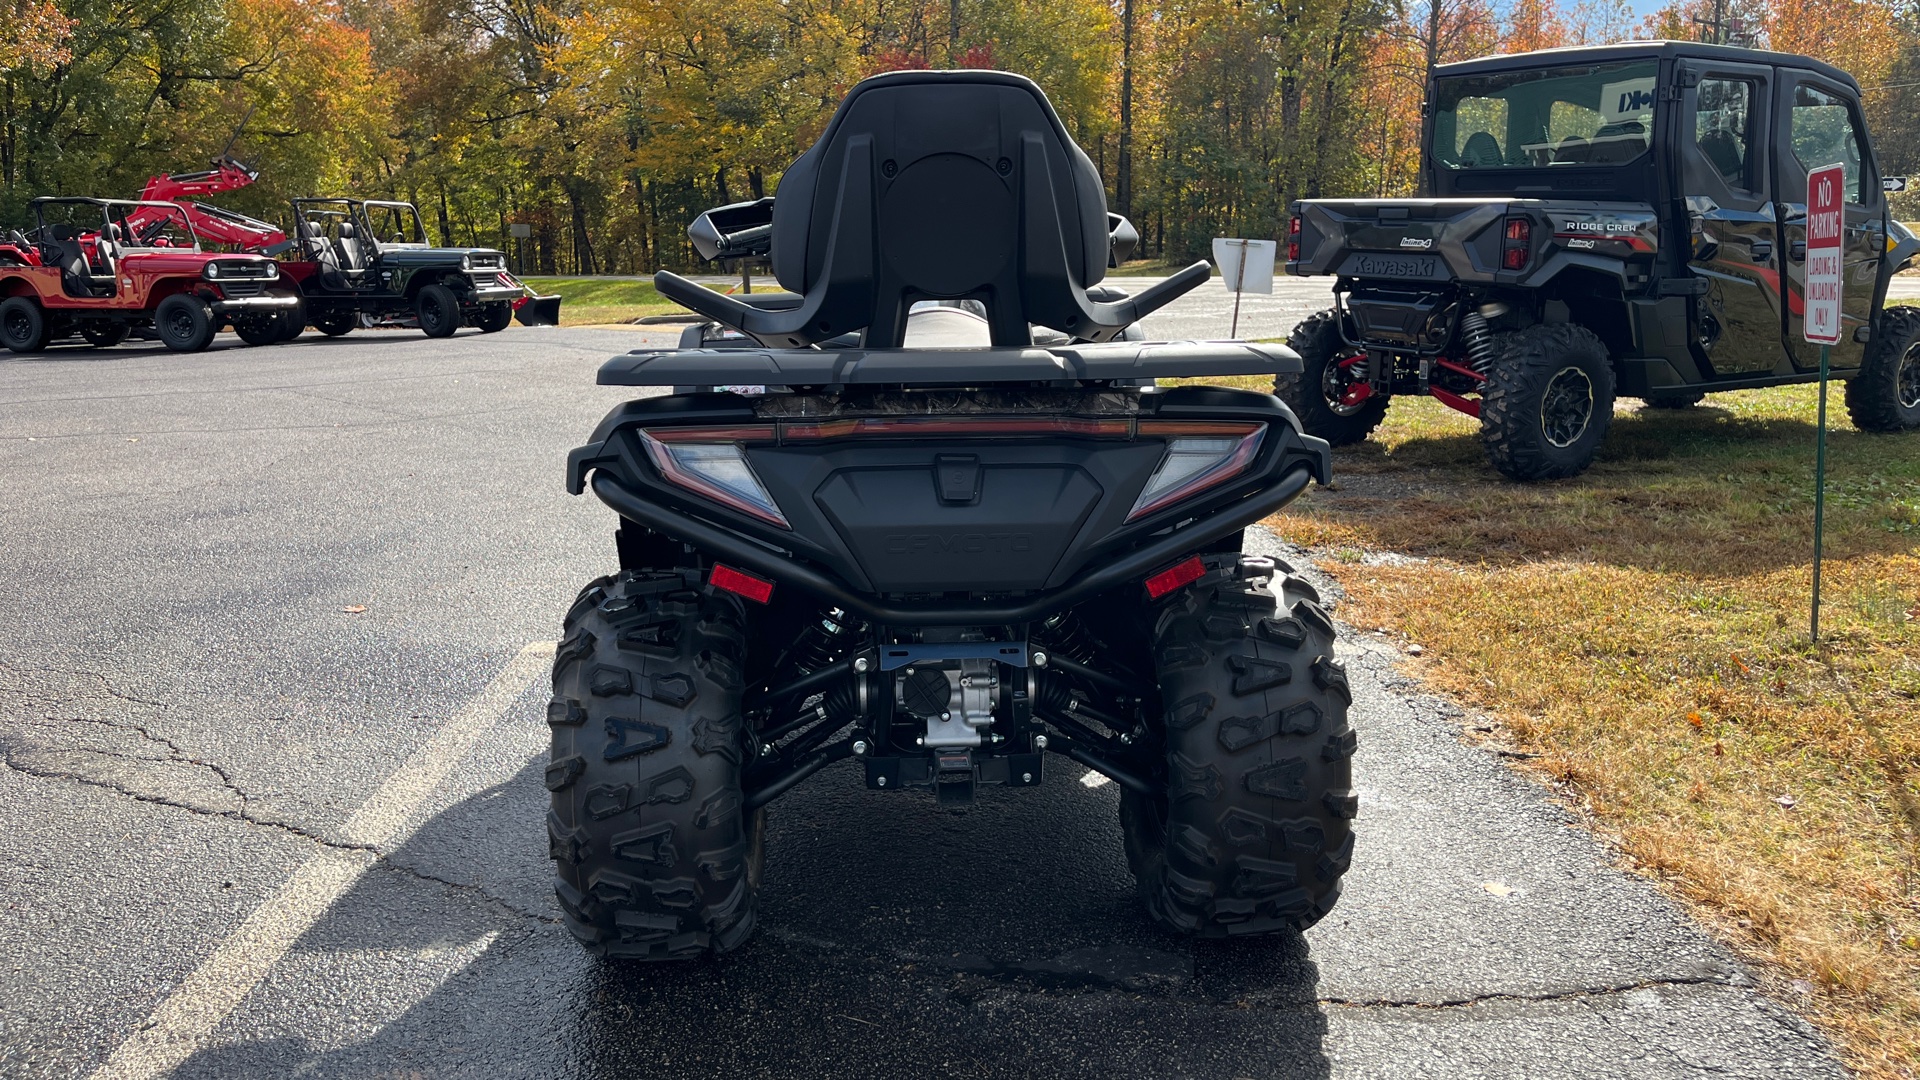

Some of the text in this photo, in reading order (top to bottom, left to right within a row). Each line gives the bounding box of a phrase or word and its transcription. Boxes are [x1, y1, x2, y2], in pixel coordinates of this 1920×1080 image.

[1818, 180, 1831, 207] NO
[1566, 222, 1637, 232] RIDGE CREW
[1810, 211, 1839, 239] PARKING
[1353, 255, 1435, 277] Kawasaki
[1809, 256, 1837, 275] LOADING &
[1808, 282, 1837, 301] UNLOADING
[1815, 308, 1828, 326] ONLY
[885, 532, 1034, 554] CFMOTO
